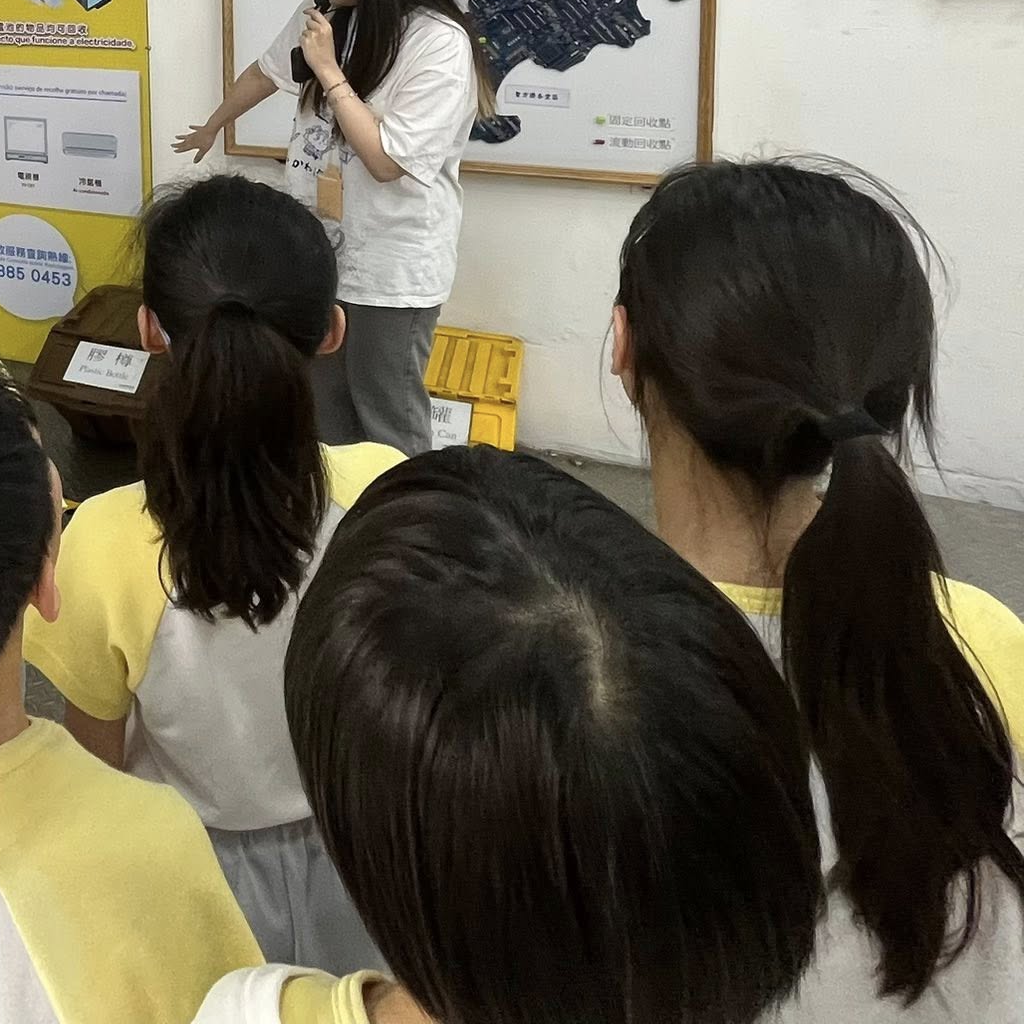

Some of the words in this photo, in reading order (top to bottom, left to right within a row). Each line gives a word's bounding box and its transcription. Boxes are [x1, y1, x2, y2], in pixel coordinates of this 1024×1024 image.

[32, 36, 67, 45] funcione
[31, 269, 71, 286] 0453
[437, 429, 457, 440] Can
